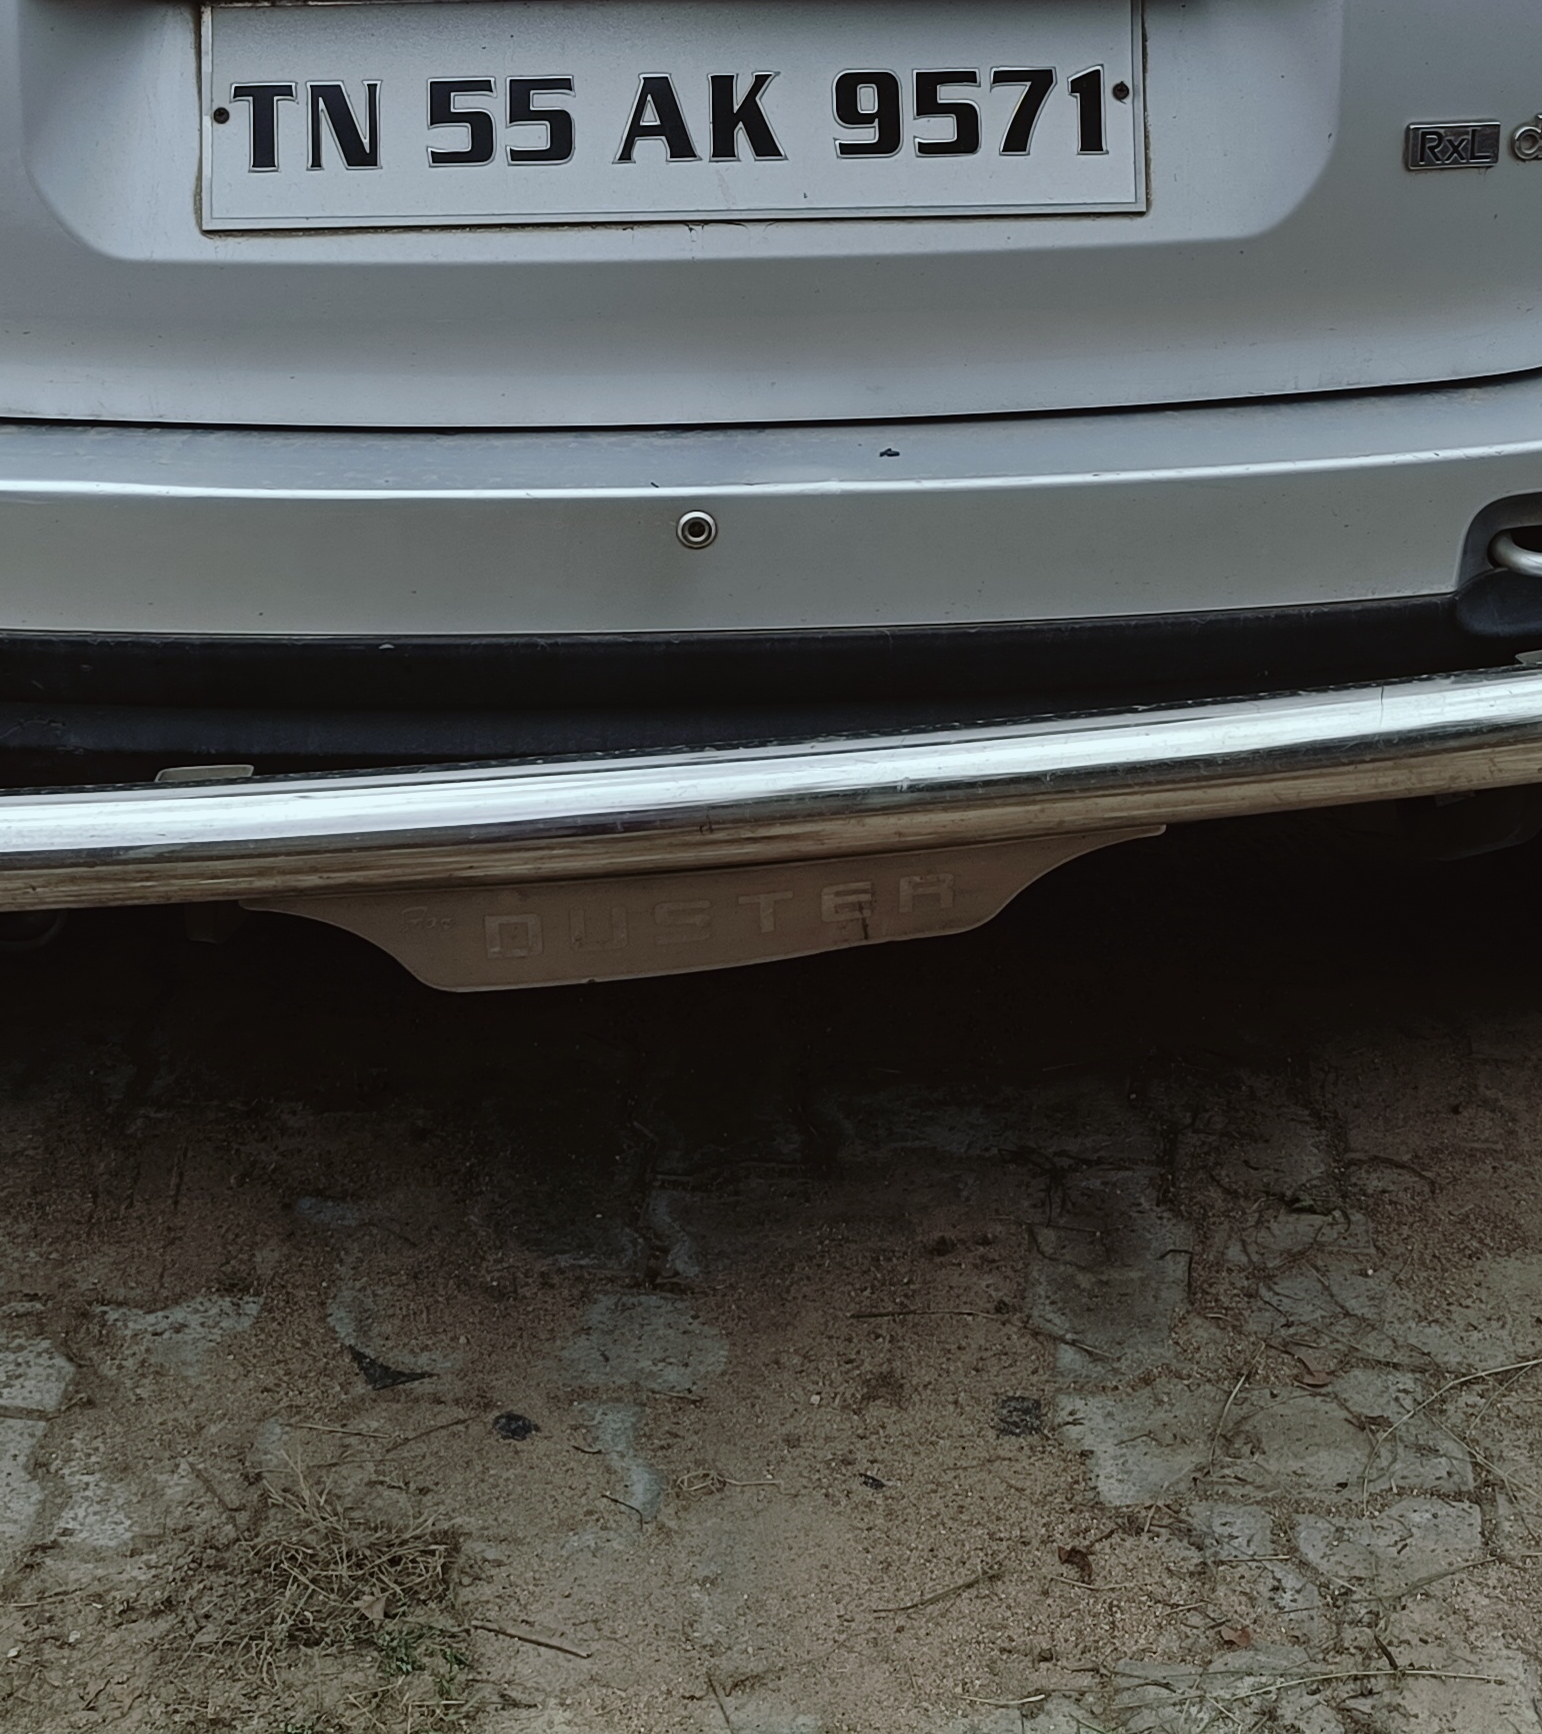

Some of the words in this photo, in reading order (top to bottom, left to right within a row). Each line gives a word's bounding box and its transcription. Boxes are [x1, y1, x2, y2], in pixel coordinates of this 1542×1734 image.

[230, 78, 382, 173] TN
[426, 74, 576, 168] 55
[612, 69, 788, 164] AK
[834, 63, 1110, 159] 9571
